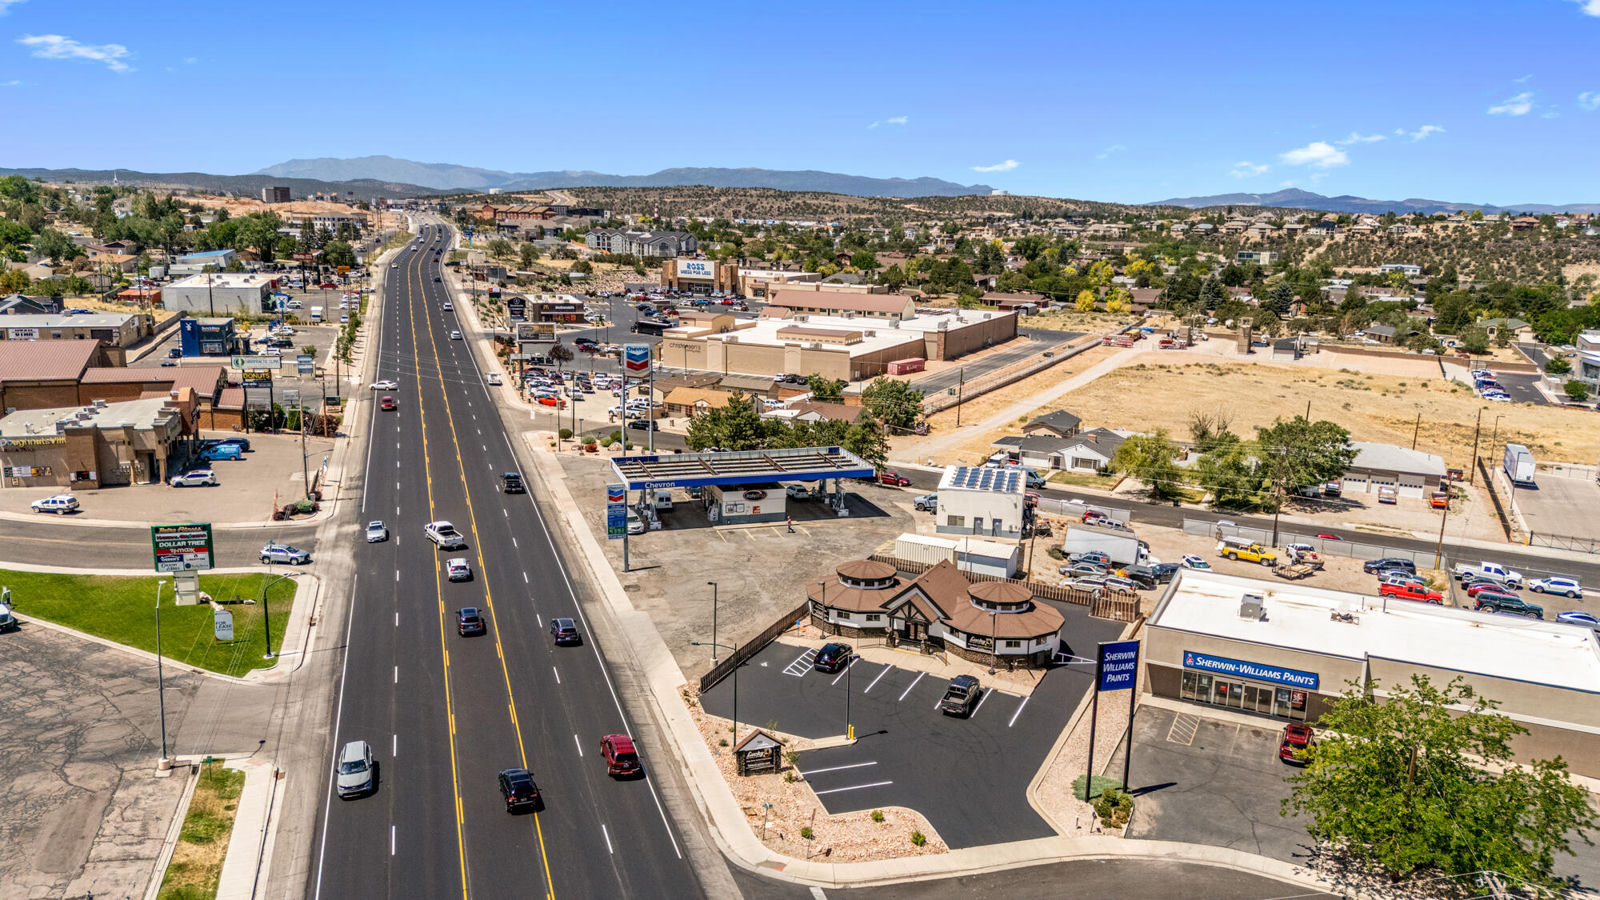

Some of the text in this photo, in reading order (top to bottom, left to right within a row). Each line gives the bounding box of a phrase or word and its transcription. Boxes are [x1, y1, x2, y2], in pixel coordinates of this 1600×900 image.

[1104, 651, 1136, 661] SHERWIN
[1103, 662, 1135, 672] WILLIAMS
[1195, 656, 1314, 685] SHERWIN-WILLIAMS PAINTS
[1106, 674, 1130, 683] PAINTS
